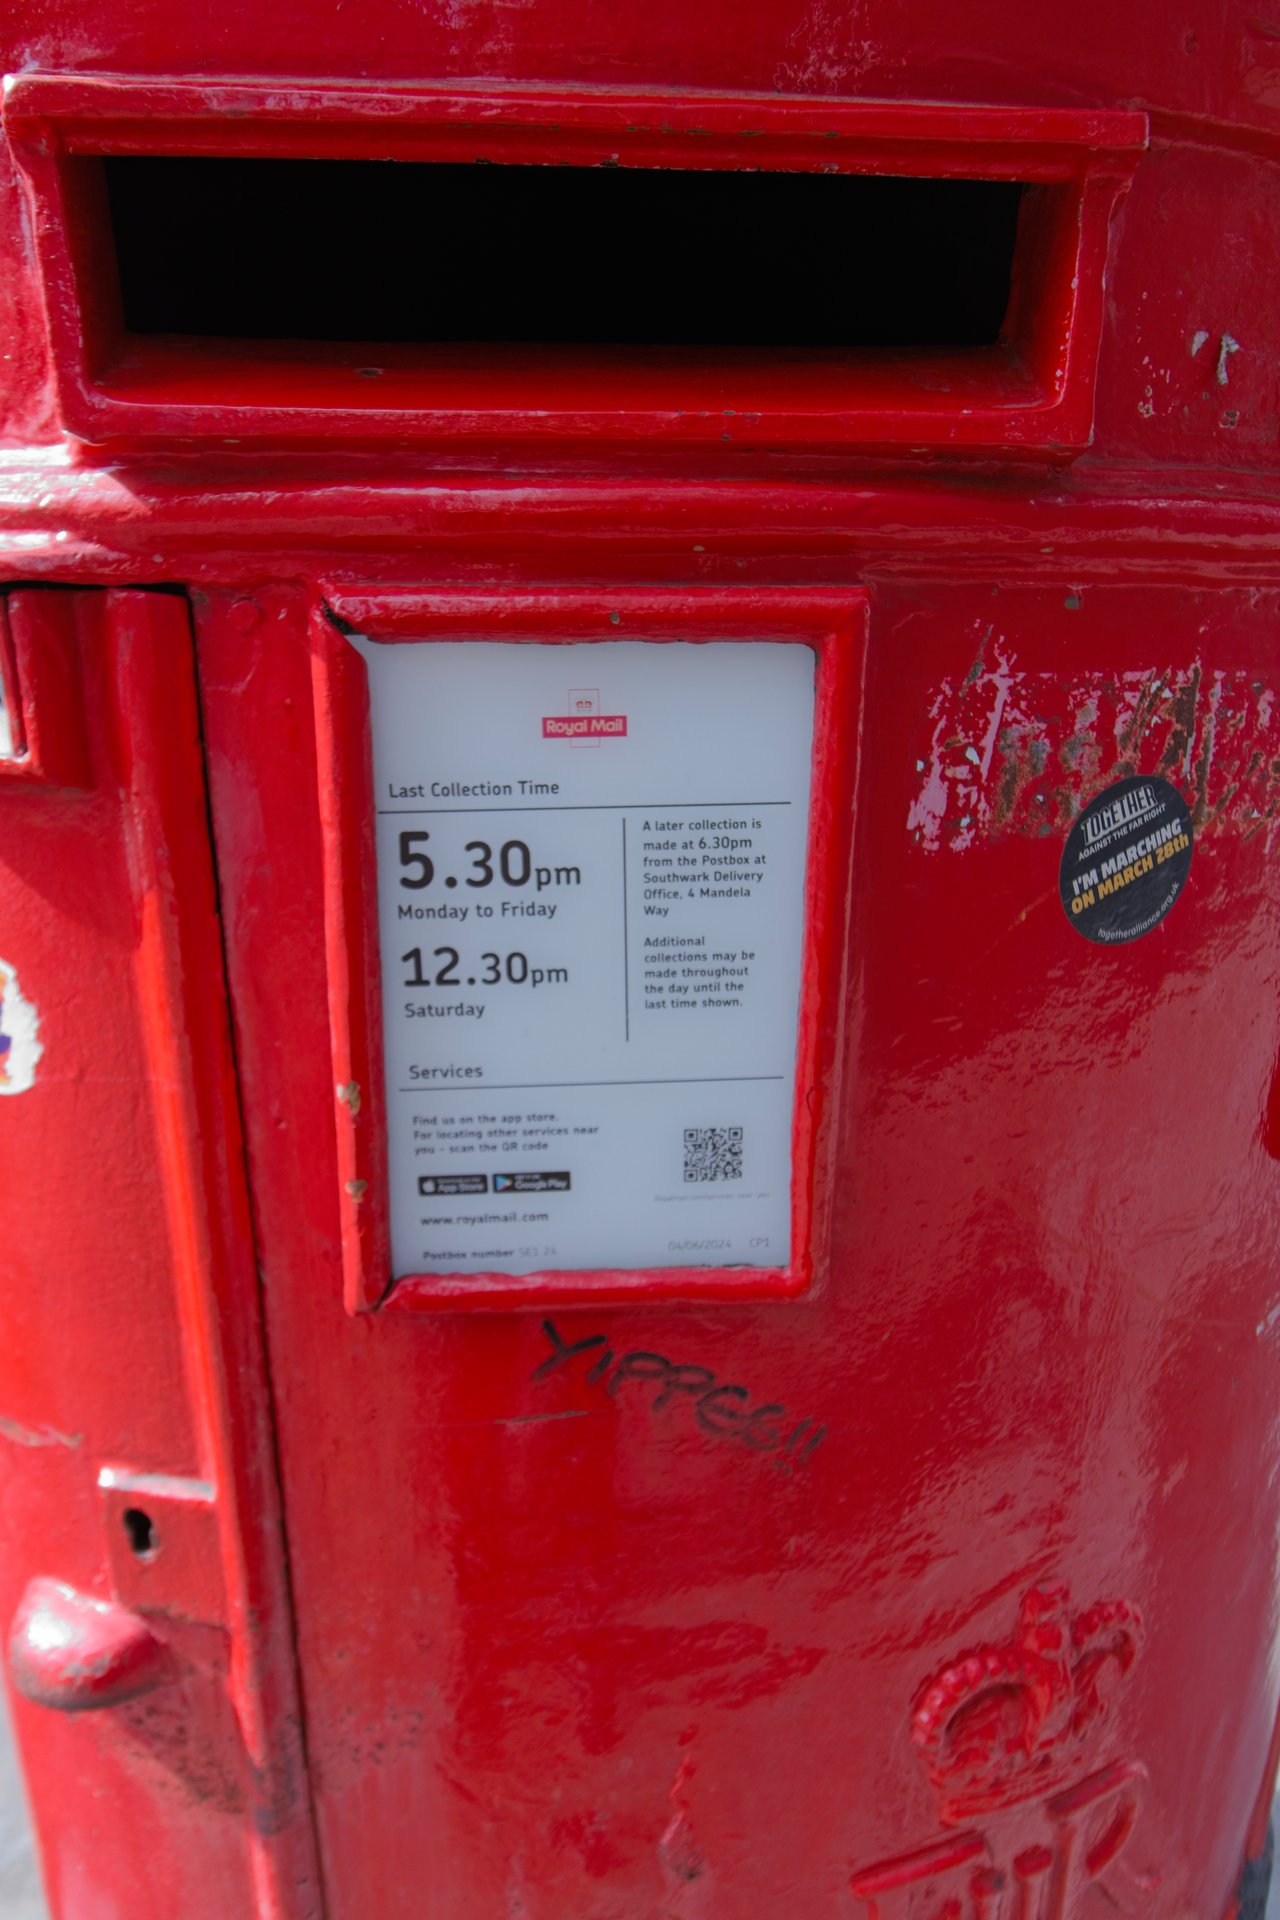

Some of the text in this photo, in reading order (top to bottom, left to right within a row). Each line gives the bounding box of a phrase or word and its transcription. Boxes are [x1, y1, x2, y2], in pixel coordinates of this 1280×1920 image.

[546, 719, 623, 735] Royal Mail
[389, 781, 559, 798] Last Collection Time
[1081, 784, 1159, 846] TOGETHER
[643, 818, 761, 831] A later collection is
[1078, 803, 1166, 862] AGAINST THE FAR RIGHT
[643, 836, 752, 851] made at 6.30pm
[400, 831, 581, 891] 5.30pm
[643, 855, 766, 867] from the Postbox at
[1072, 818, 1182, 895] I'M MARCHING
[644, 871, 763, 883] Southwark Delivery
[1071, 833, 1189, 914] ON MARCH 28th
[688, 888, 695, 898] 4
[700, 887, 750, 897] Mandela
[398, 902, 557, 921] Monday to Friday
[644, 906, 669, 917] Way
[1098, 882, 1180, 940] togetheralliance.org.uk
[644, 936, 704, 947] Additional
[644, 950, 755, 963] collections may be
[402, 947, 568, 988] 12.30pm
[645, 967, 748, 979] made throughout
[645, 982, 744, 995] the day until the
[645, 998, 742, 1009] last time shown.
[405, 1002, 485, 1019] Saturday
[409, 1064, 483, 1079] Services
[413, 1116, 437, 1125] Find
[478, 1115, 496, 1123] the
[501, 1115, 522, 1124] app
[526, 1114, 559, 1122] store.
[414, 1131, 432, 1139] For
[437, 1130, 482, 1139] locating
[487, 1129, 517, 1137] other
[522, 1127, 568, 1136] services
[415, 1147, 435, 1155] you
[502, 1142, 518, 1151] QR
[523, 1142, 548, 1150] code
[421, 1213, 548, 1225] www.royalmail.com
[424, 1252, 466, 1260] Postbox
[472, 1250, 514, 1258] number
